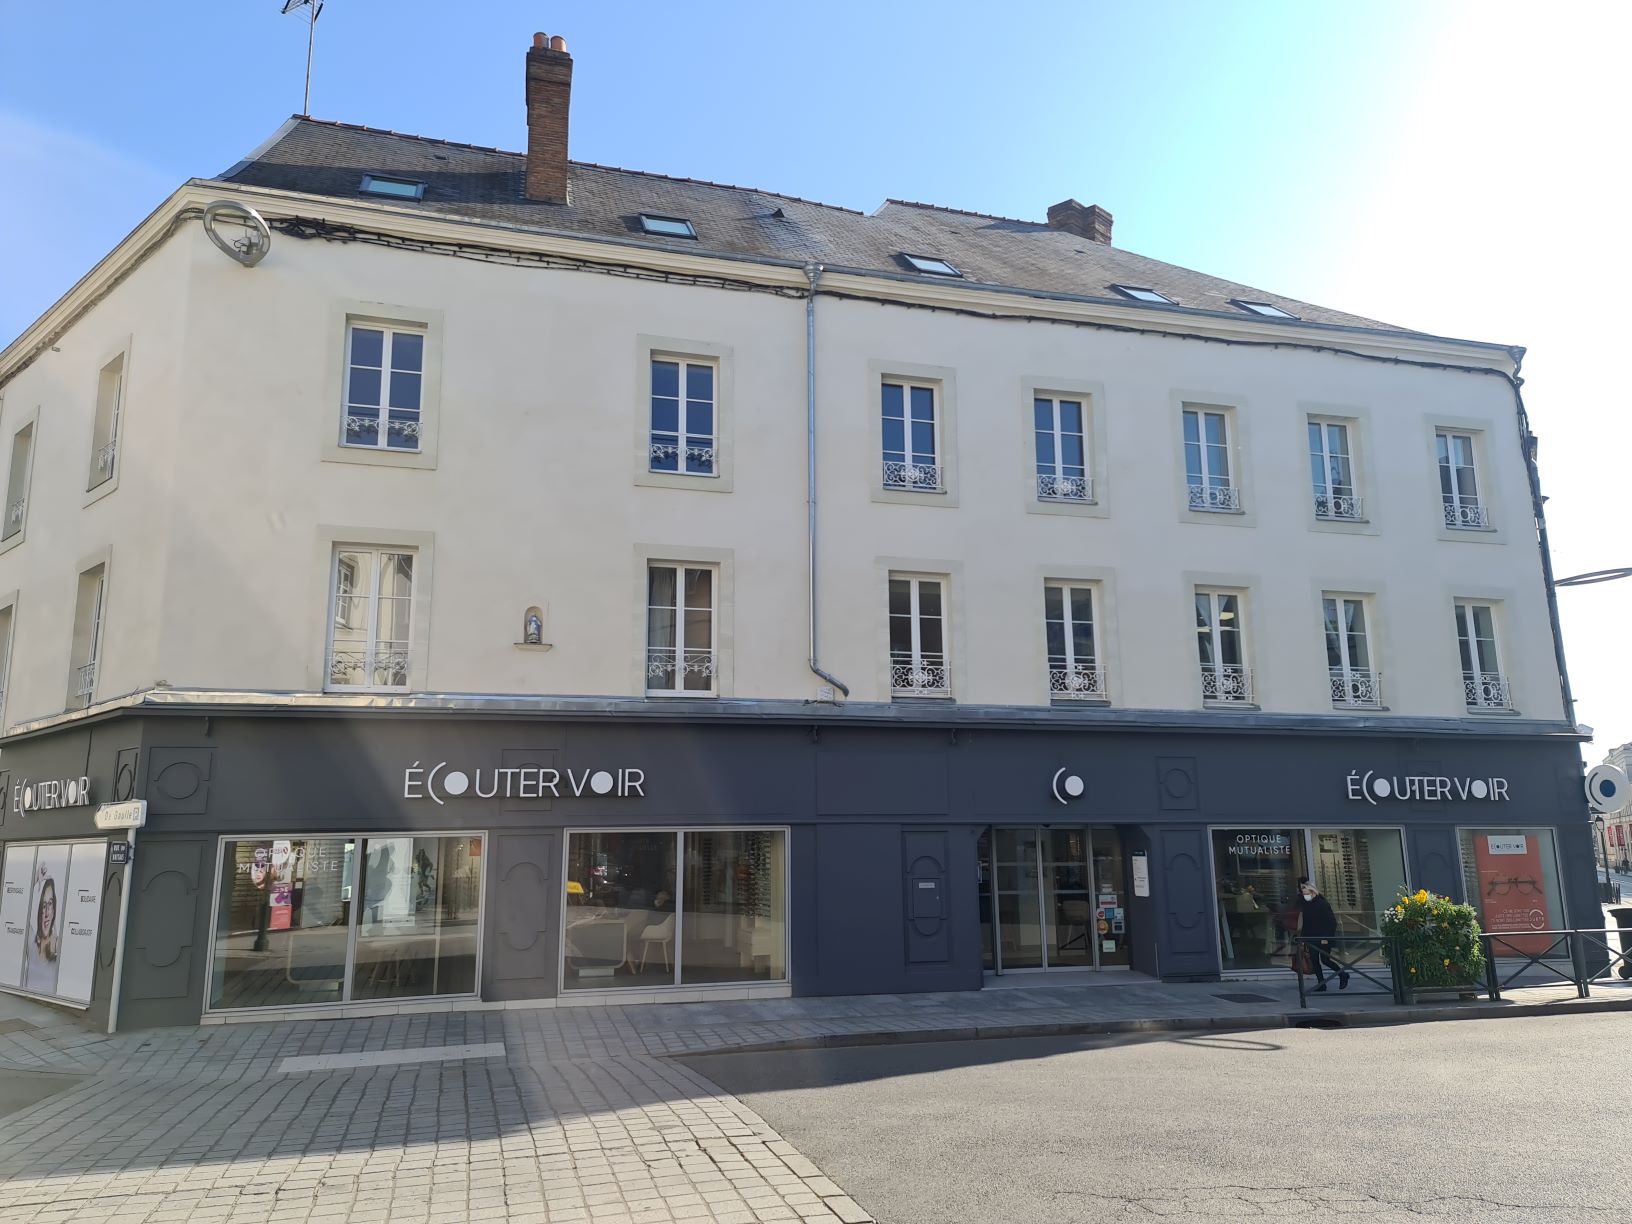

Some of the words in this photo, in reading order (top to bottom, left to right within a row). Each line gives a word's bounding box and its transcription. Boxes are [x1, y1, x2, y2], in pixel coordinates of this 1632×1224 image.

[60, 776, 90, 809] VOIR
[404, 760, 560, 805] ÉCOUTER
[567, 768, 646, 798] VOIR
[1346, 769, 1452, 806] ÉCOUTER
[1454, 776, 1510, 801] VOIR
[1228, 845, 1291, 855] MUTUALISTE
[1236, 834, 1282, 845] OPTIQUE
